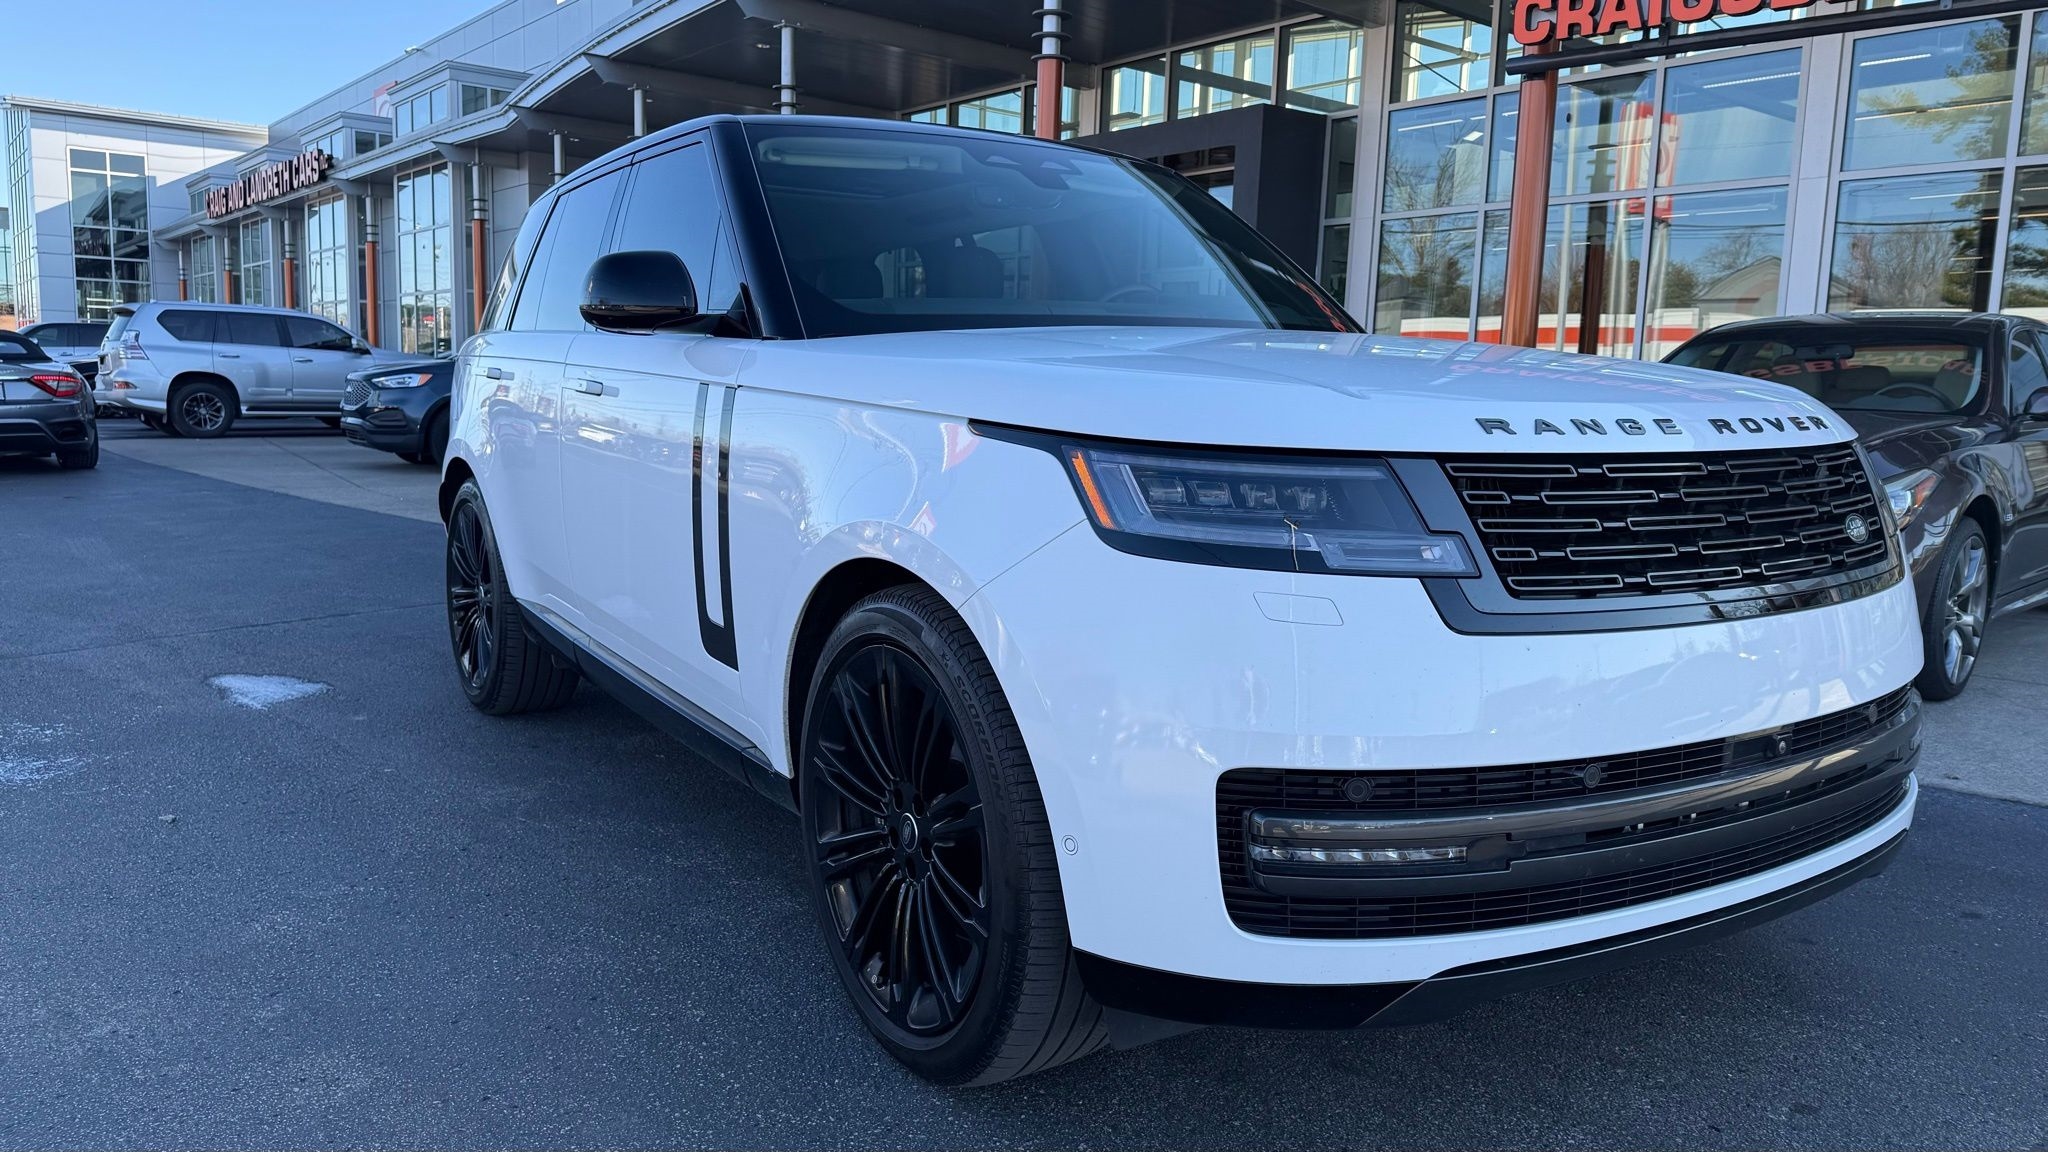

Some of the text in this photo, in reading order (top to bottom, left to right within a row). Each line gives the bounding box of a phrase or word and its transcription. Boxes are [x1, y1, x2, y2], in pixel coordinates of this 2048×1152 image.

[206, 187, 226, 219] CRAIG
[228, 180, 243, 212] AND
[246, 161, 290, 205] LANDRETH
[292, 150, 319, 188] CARS
[1475, 414, 1830, 436] RANGE ROVER
